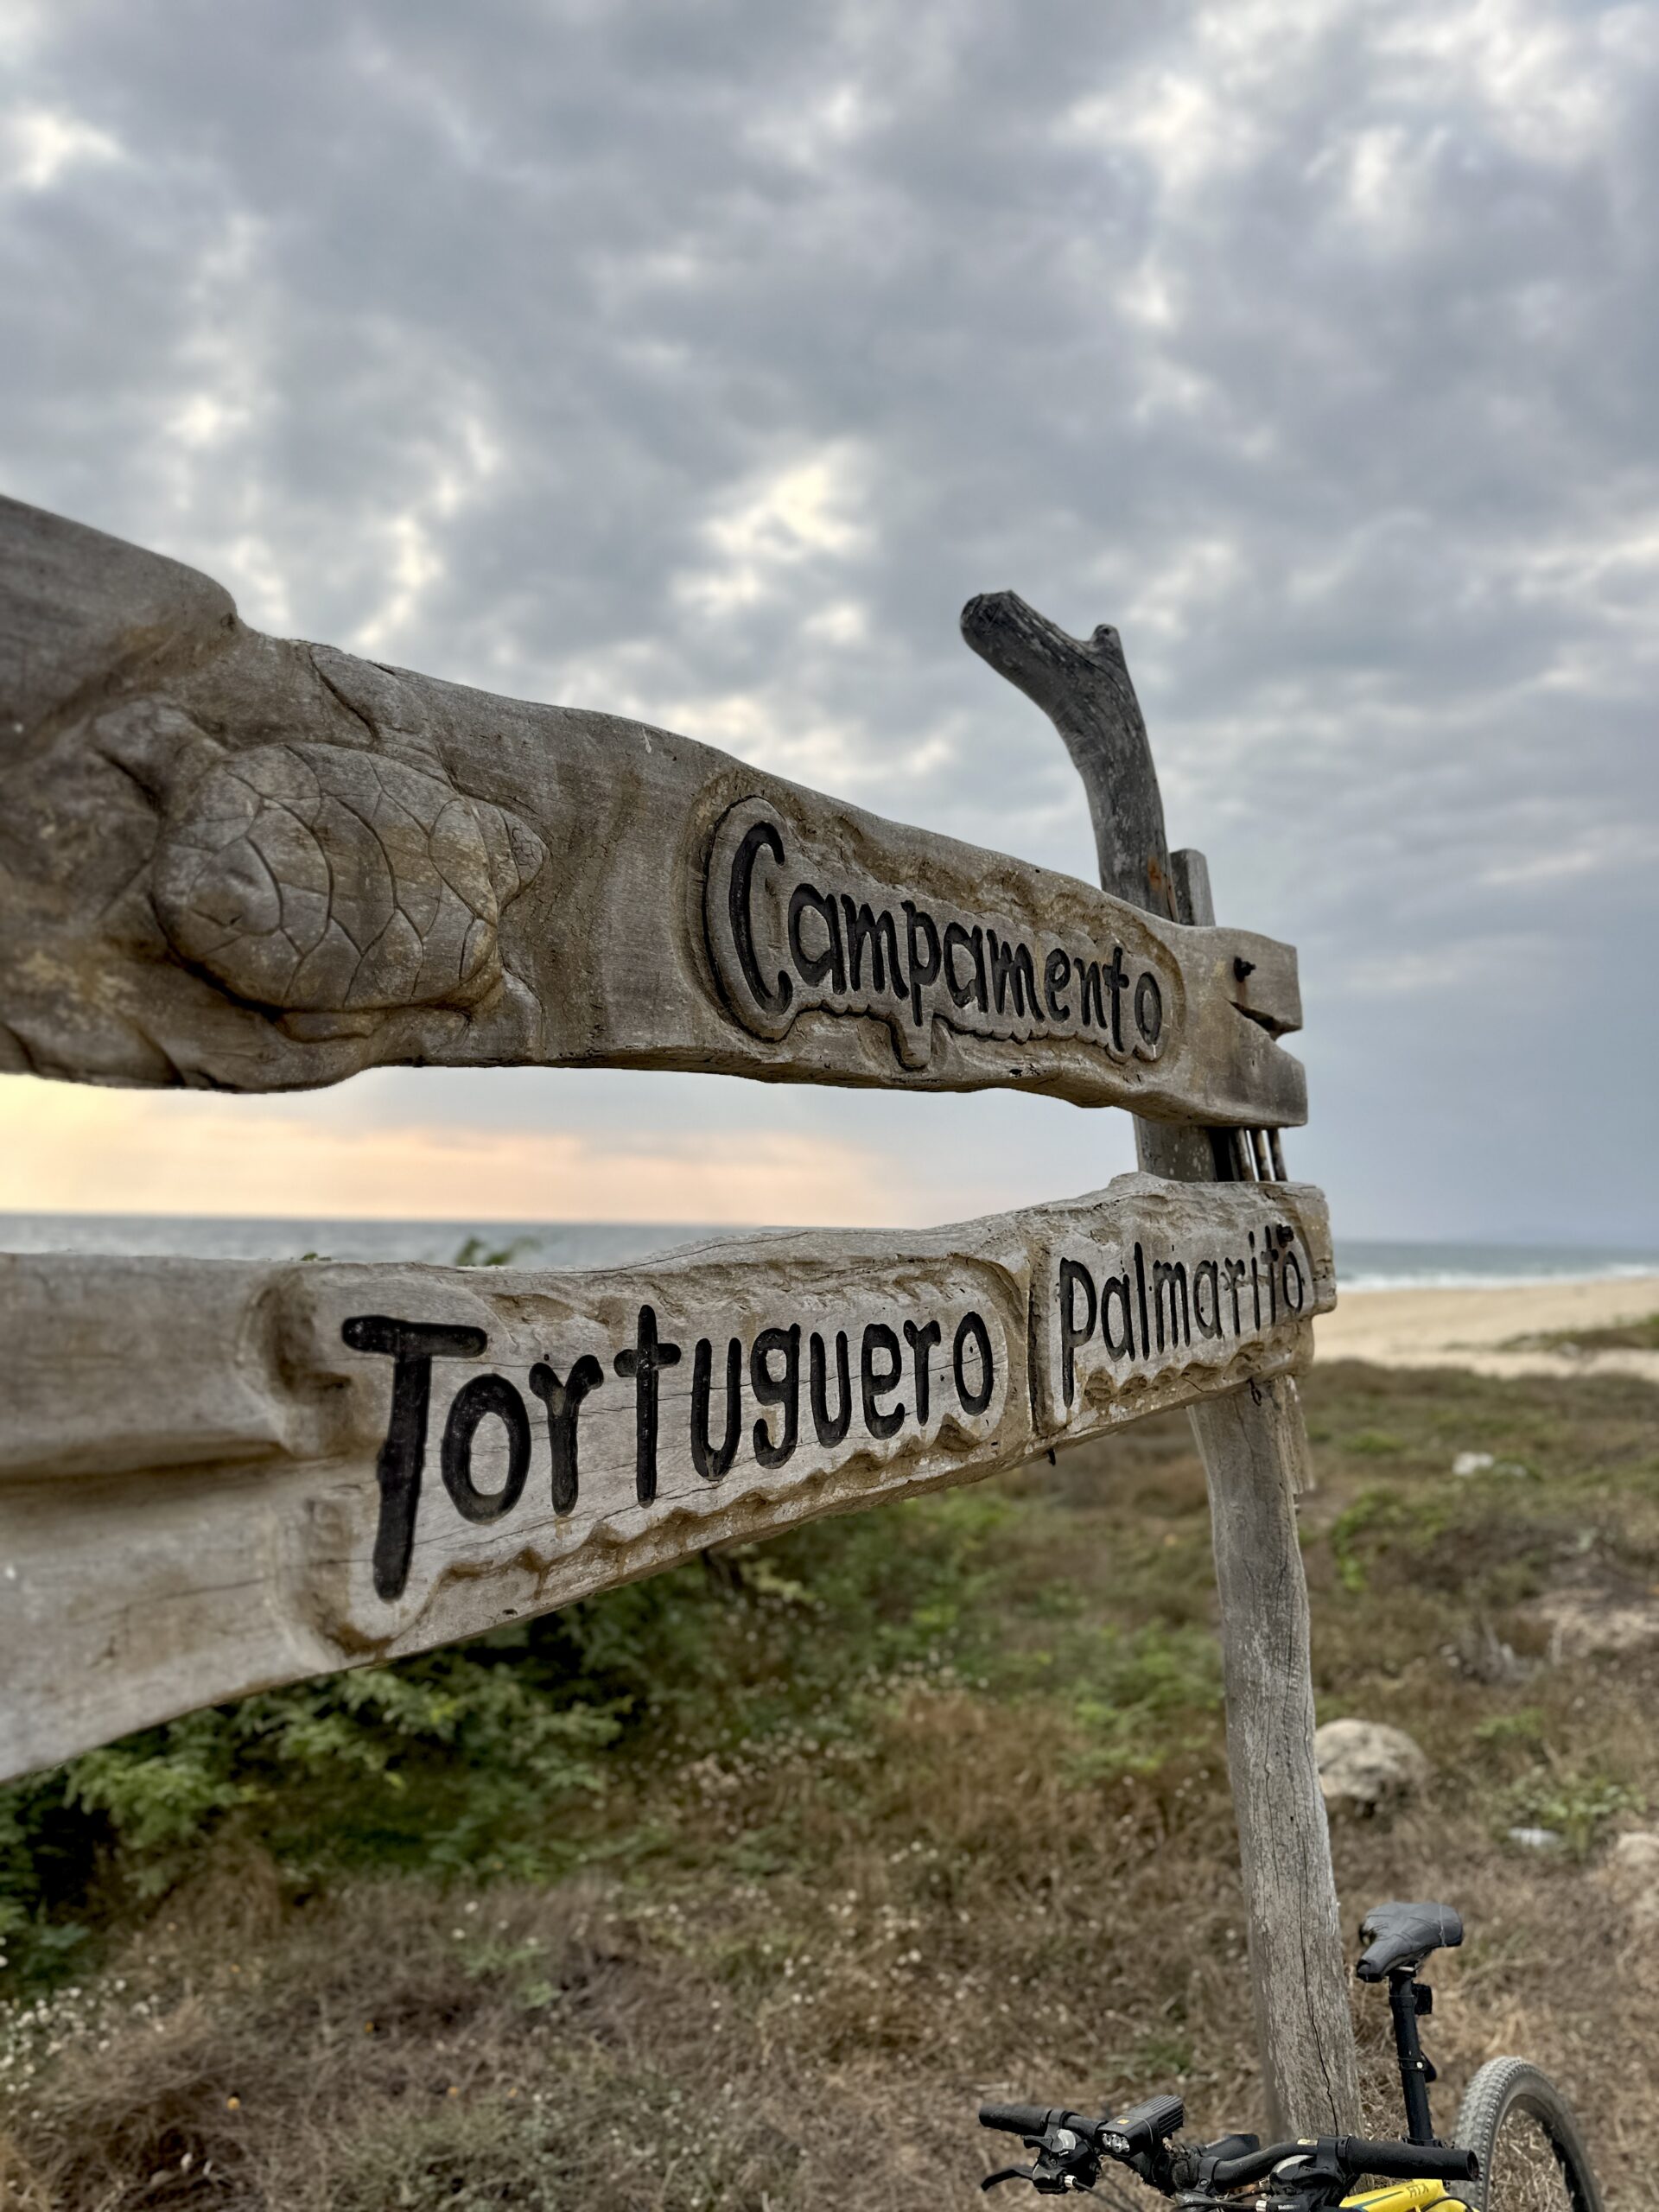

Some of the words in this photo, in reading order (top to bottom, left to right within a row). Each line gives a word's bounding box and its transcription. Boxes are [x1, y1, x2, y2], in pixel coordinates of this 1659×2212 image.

[728, 821, 1163, 1052] Campamento
[340, 1304, 994, 1603] Tortuguero
[1058, 1225, 1303, 1408] Palmarito
